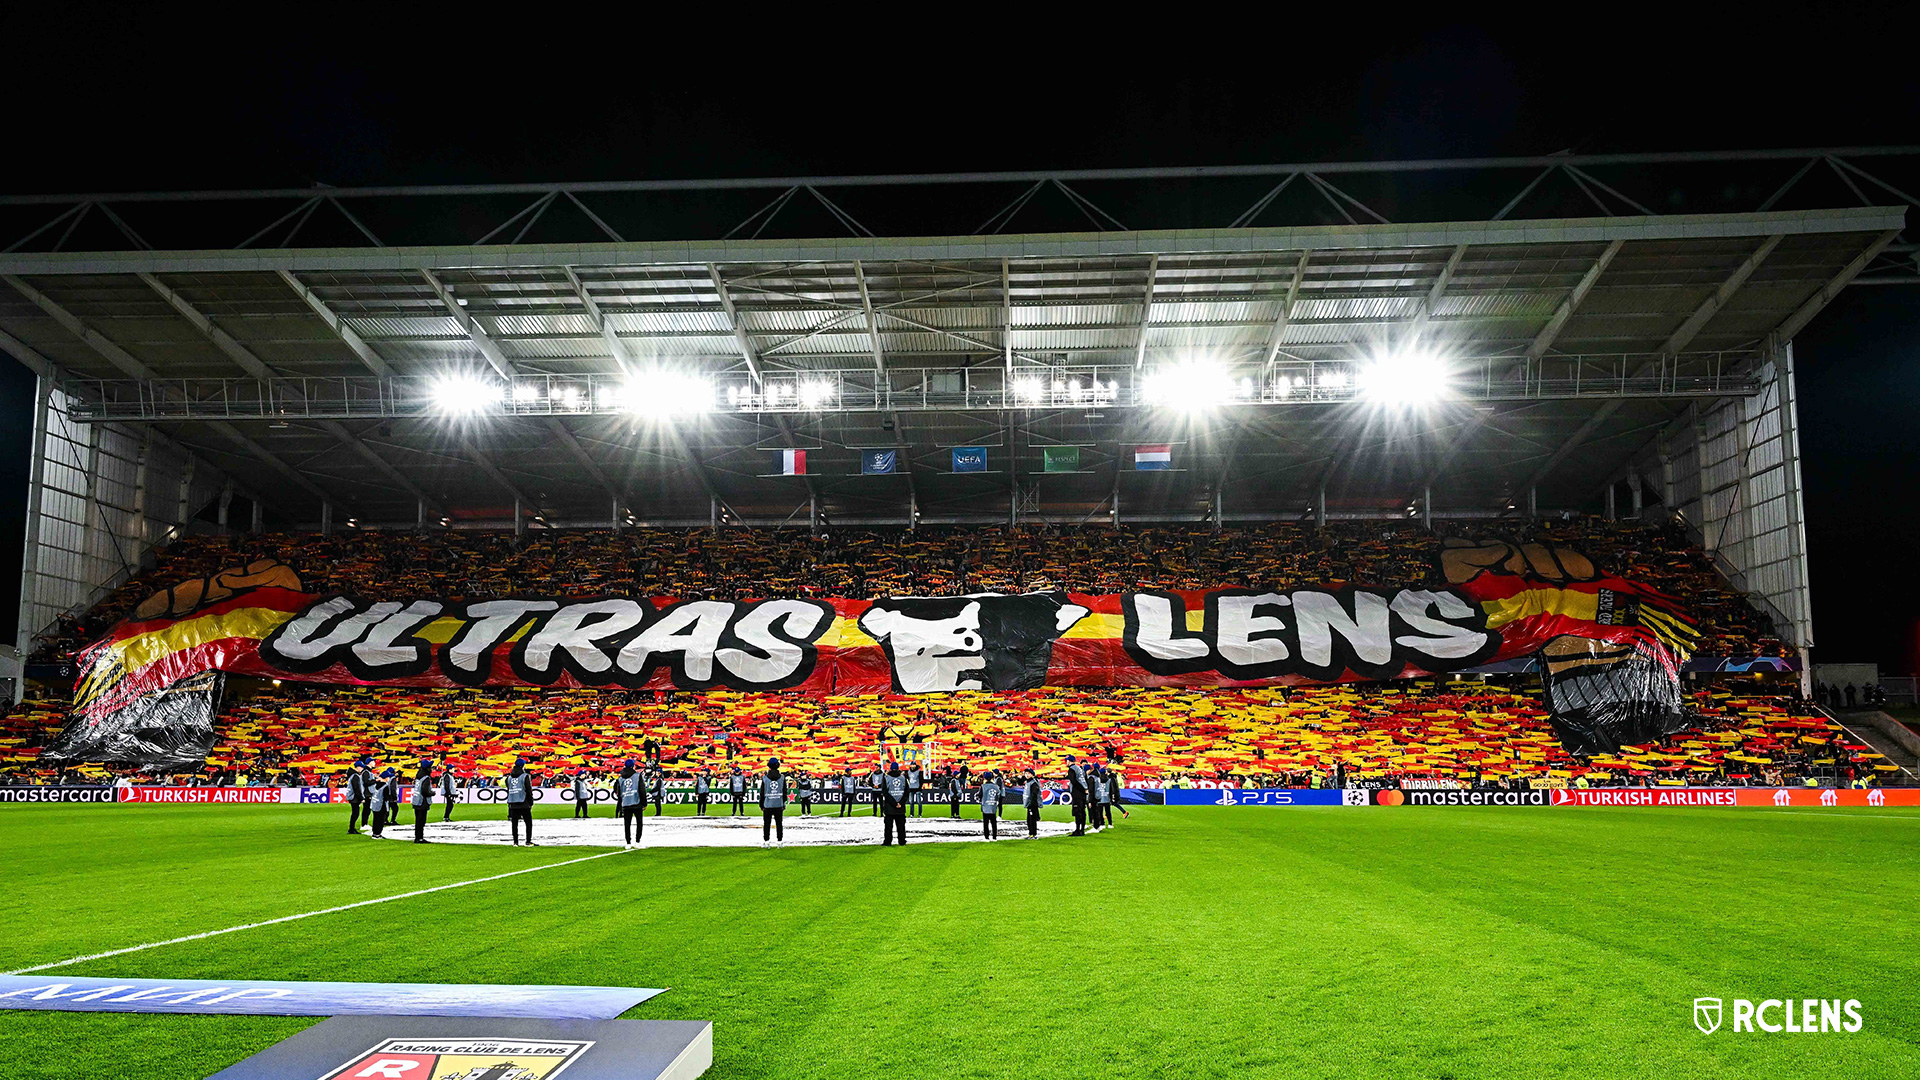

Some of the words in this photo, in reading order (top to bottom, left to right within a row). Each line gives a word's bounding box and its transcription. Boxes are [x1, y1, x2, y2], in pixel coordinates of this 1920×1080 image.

[957, 455, 981, 464] UEFA
[272, 595, 824, 683] ULTRAS
[1133, 588, 1488, 667] LENS
[143, 790, 211, 803] TURKISH
[212, 790, 281, 803] AIRLINES
[301, 788, 349, 804] FedEx
[477, 788, 544, 804] opo
[646, 789, 685, 805] ejoy
[1242, 791, 1292, 804] PS5
[1411, 789, 1543, 805] mastercard
[1577, 791, 1652, 805] TURKISH
[1658, 791, 1734, 805] AIRLINES
[389, 1044, 451, 1053] RACING
[453, 1045, 496, 1054] CLUB
[500, 1046, 522, 1054] DE
[524, 1047, 568, 1055] LENS
[354, 1058, 420, 1078] R
